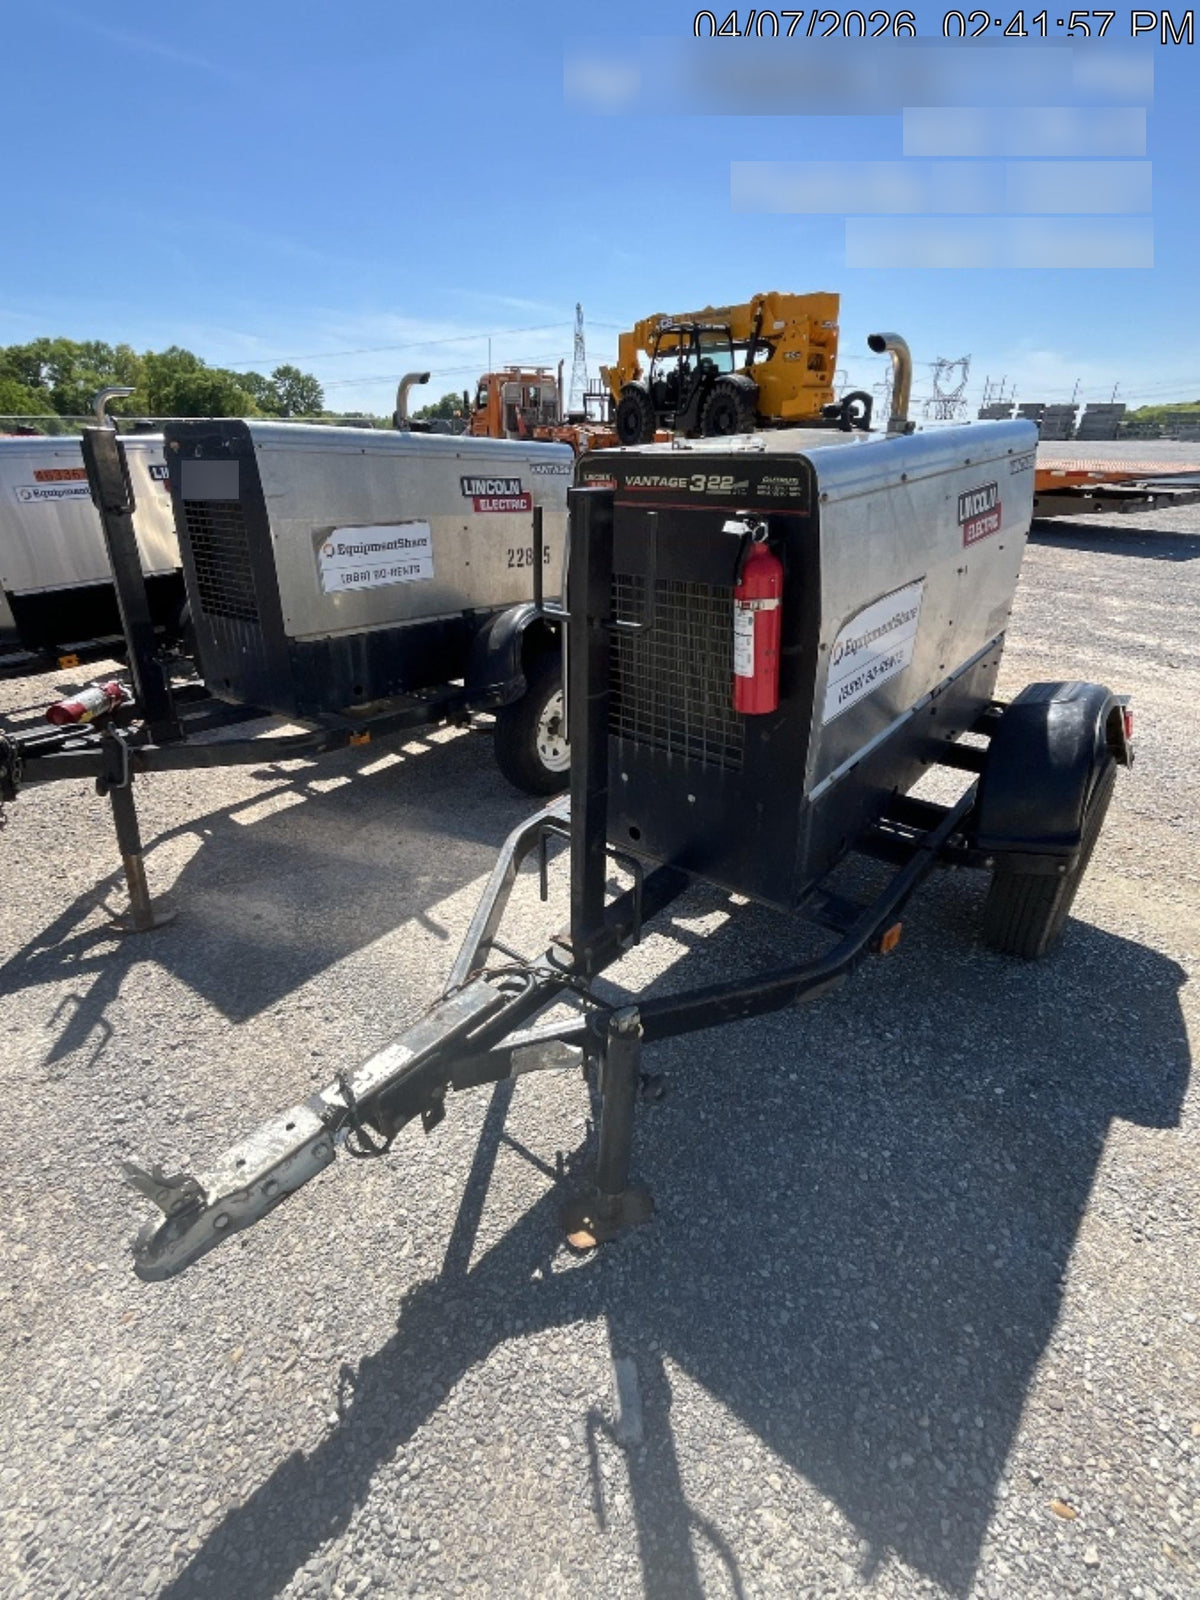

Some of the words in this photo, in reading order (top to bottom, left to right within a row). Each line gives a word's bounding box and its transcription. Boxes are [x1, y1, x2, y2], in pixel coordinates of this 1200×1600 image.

[463, 478, 521, 496] LINCOLN
[624, 475, 690, 489] VANTAGE
[689, 474, 734, 492] 322
[32, 486, 91, 499] Equipment
[479, 498, 528, 511] ELECTRIC
[959, 485, 998, 523] LINCOLN
[967, 512, 1000, 542] ELECTRIC
[336, 538, 428, 556] EquipmentShare
[507, 546, 551, 568] 2285
